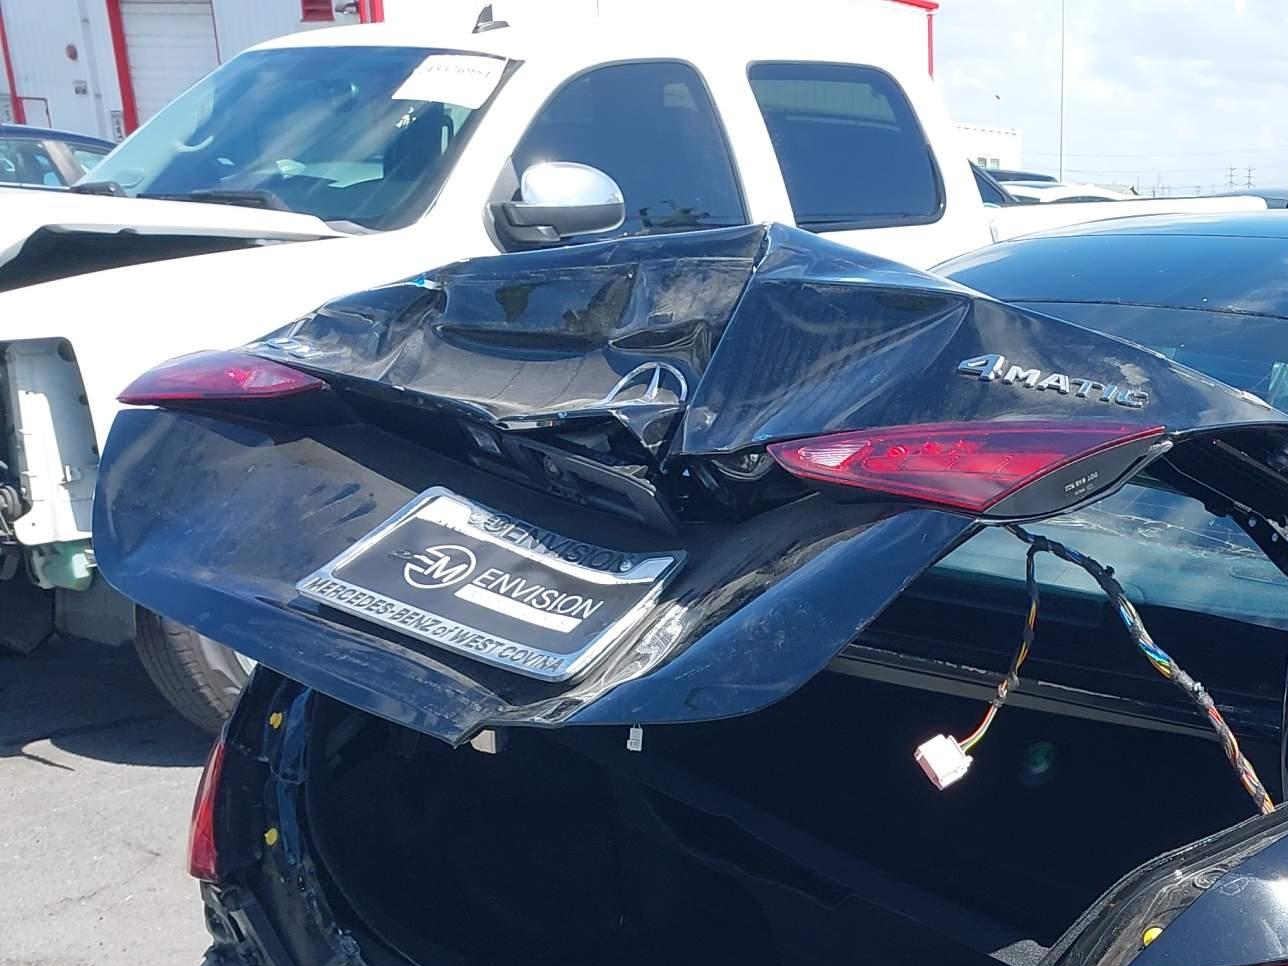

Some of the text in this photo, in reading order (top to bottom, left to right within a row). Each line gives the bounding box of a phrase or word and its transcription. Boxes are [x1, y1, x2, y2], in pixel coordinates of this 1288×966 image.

[957, 353, 1150, 408] 4MATIC
[500, 516, 627, 573] ENVISION
[472, 568, 604, 619] ENVISION
[303, 577, 564, 673] MERCEDES-BENZ of WEST COVINA
